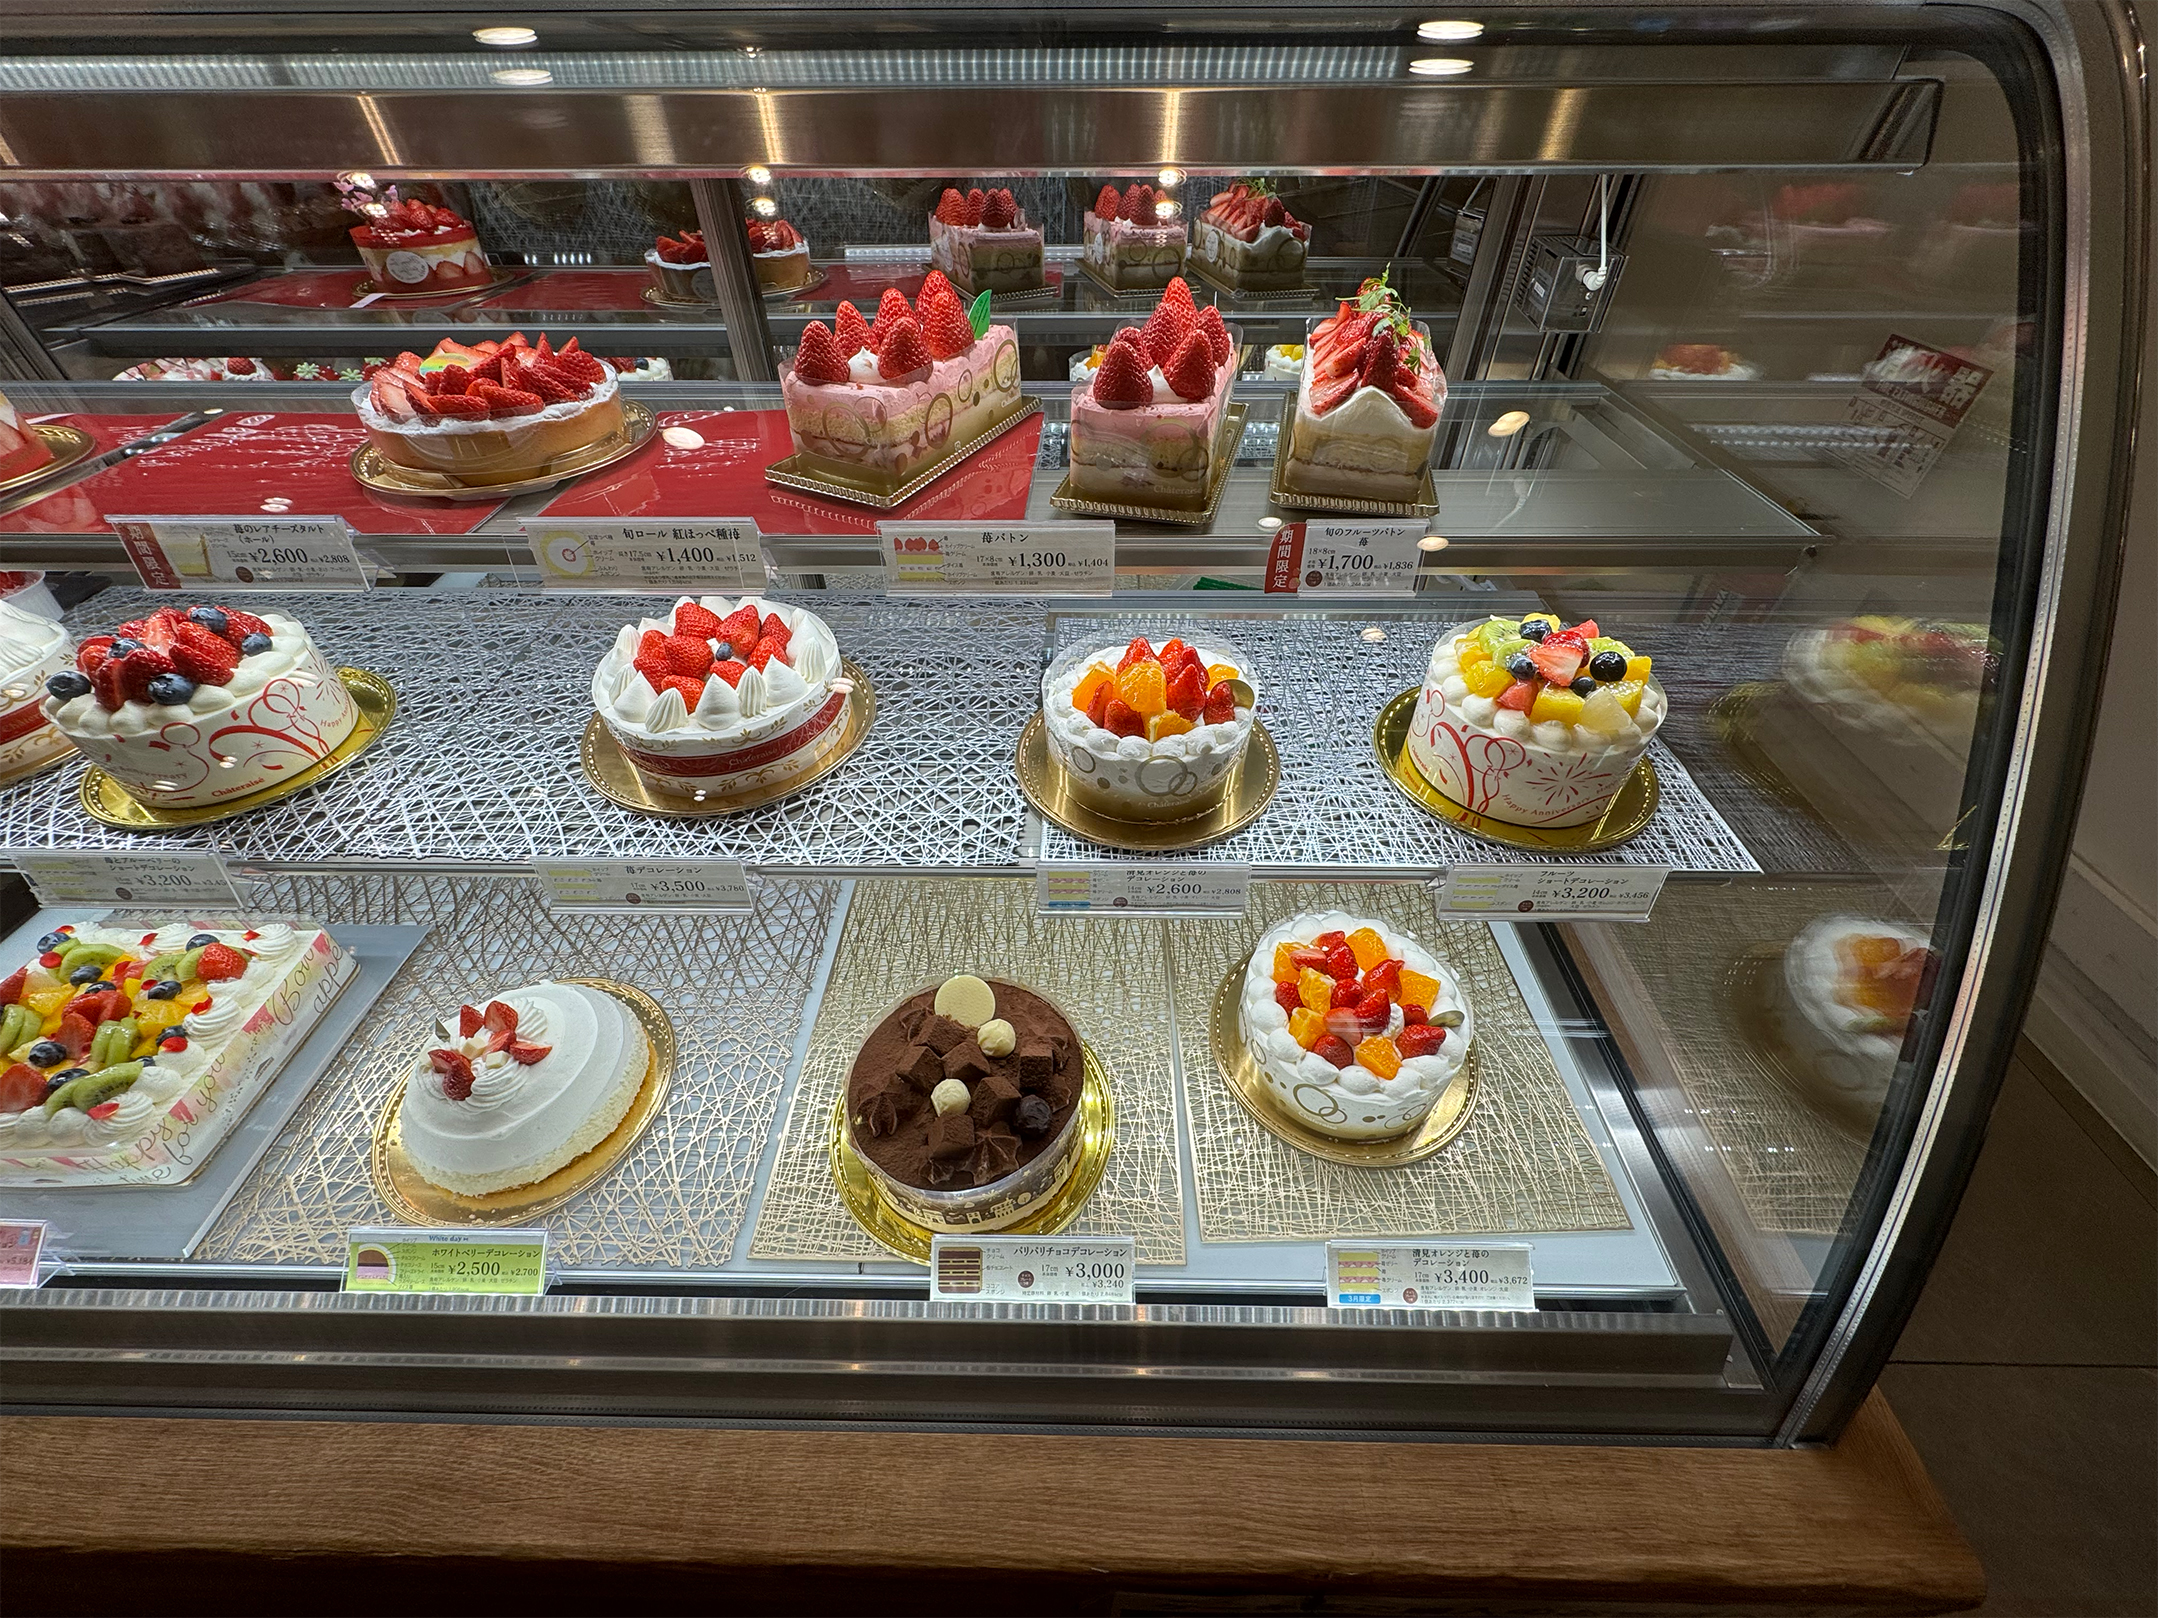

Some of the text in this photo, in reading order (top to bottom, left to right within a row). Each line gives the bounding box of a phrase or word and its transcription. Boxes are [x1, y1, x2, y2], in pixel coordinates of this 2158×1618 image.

[234, 524, 324, 534] 苺のレアチーズタルト
[622, 528, 668, 540] 旬ロール
[1325, 527, 1406, 537] 旬のフルーツバトン
[981, 532, 1029, 544] 苺バトン
[248, 548, 308, 566] ¥2,600
[318, 554, 350, 564] ¥2,808
[656, 547, 714, 564] ¥1,400
[1008, 552, 1066, 569] ¥1,300
[1078, 558, 1108, 568] ¥1,404
[1272, 529, 1294, 588] 期間限定
[1318, 554, 1374, 571] ¥1,700
[1384, 562, 1414, 570] ¥1,836
[320, 718, 342, 728] Happy
[211, 776, 266, 798] Châteraisé
[1502, 793, 1591, 816] Happy Anniversary
[624, 866, 702, 875] 苺デコレーション
[136, 874, 192, 886] ¥3,200
[650, 880, 705, 894] ¥3,500
[716, 884, 745, 892] ¥3,780
[1148, 884, 1202, 895] ¥2,600
[1552, 887, 1610, 900] ¥3,200
[272, 948, 314, 1026] Bon
[196, 1054, 226, 1112] you
[80, 1117, 172, 1174] Happy
[432, 1248, 541, 1258] ホワイトベリーデコレーション
[1014, 1246, 1127, 1258] パリパリチョコデコレーション
[1412, 1248, 1490, 1258] 清見オレンジと苺の
[449, 1261, 500, 1276] ¥2,500
[510, 1268, 538, 1276] ¥2,700
[1413, 1258, 1470, 1267] デコレーション
[1041, 1262, 1125, 1280] 17cm ¥3,000
[1435, 1268, 1489, 1286] ¥3,400
[1498, 1276, 1528, 1284] ¥3,672
[1092, 1280, 1124, 1288] ¥3,240
